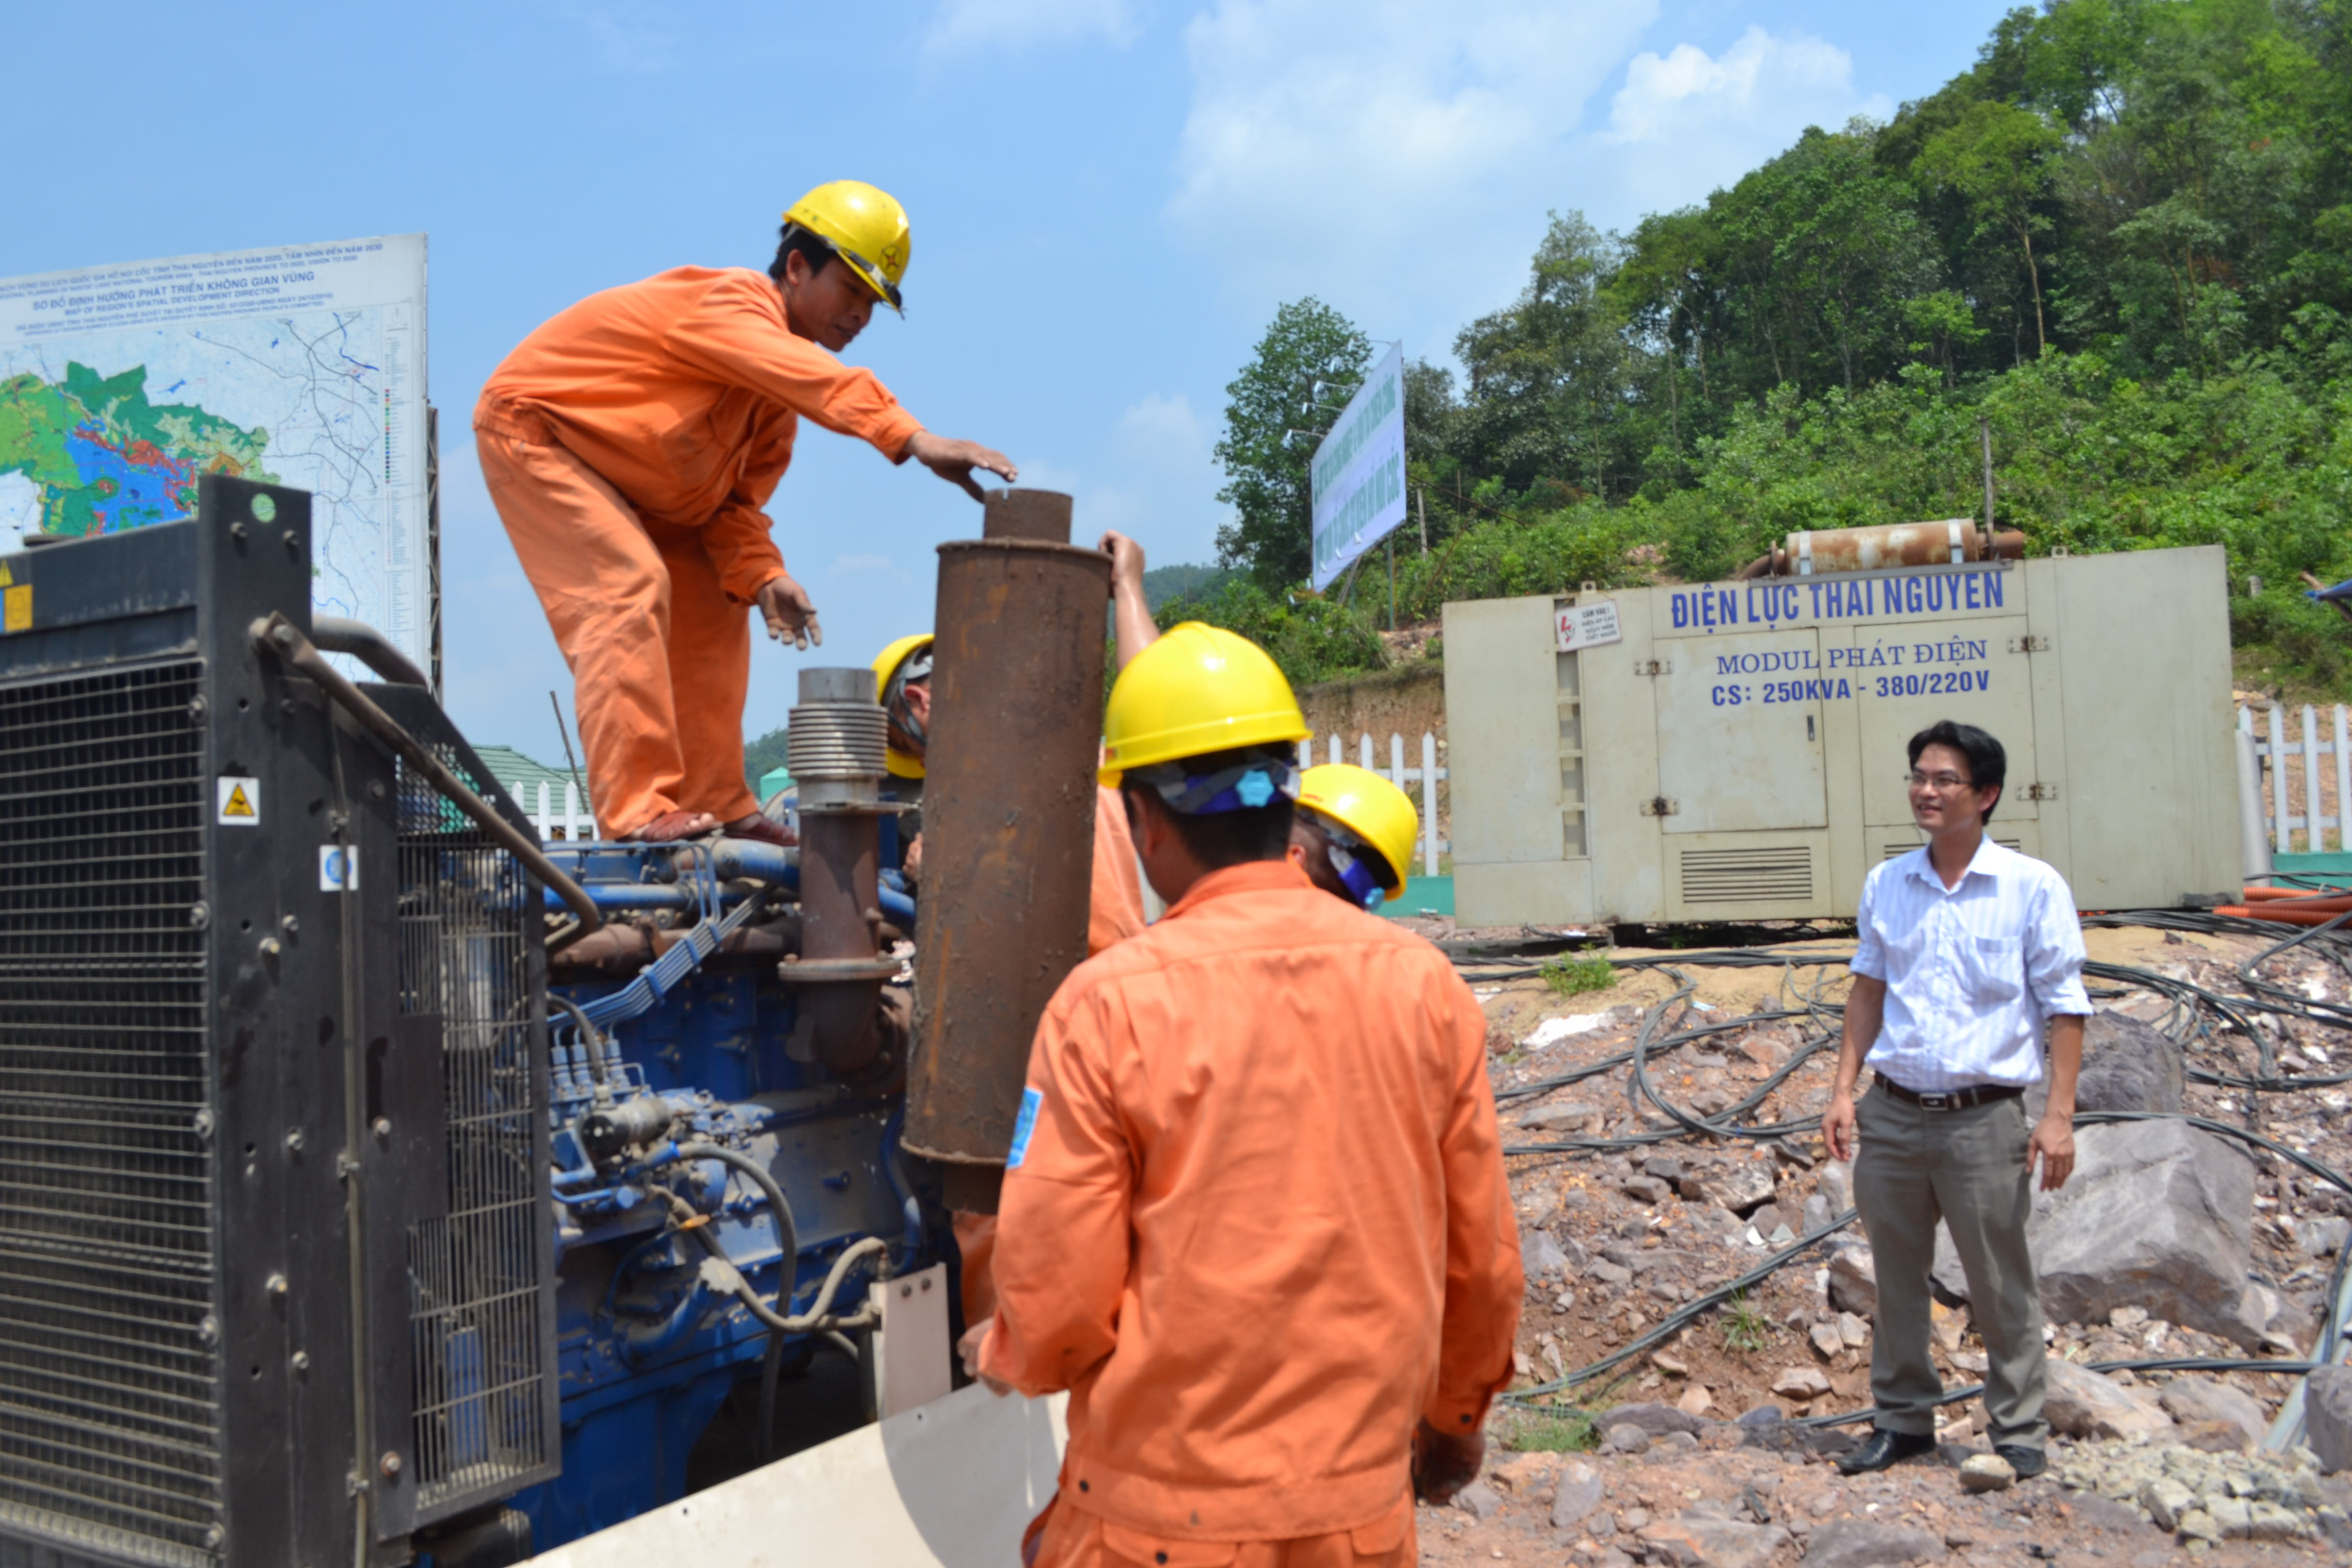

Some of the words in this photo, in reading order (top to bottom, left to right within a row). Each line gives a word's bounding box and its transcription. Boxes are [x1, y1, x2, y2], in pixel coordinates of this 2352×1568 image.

[65, 307, 81, 316] MAP
[136, 298, 168, 307] SPATIAL
[171, 290, 232, 304] DEVELOPMENT
[235, 285, 280, 297] DIRECTION
[1672, 583, 1737, 633] ĐIỆN
[1747, 584, 1799, 629] LỰC
[1717, 650, 1820, 675] MODUL
[1828, 639, 1905, 668] PHÁT
[1914, 635, 1987, 666] ĐIỆN
[1712, 684, 1751, 706] CS:
[1763, 678, 1851, 703] 250KVA
[1876, 670, 1990, 697] 380/220V
